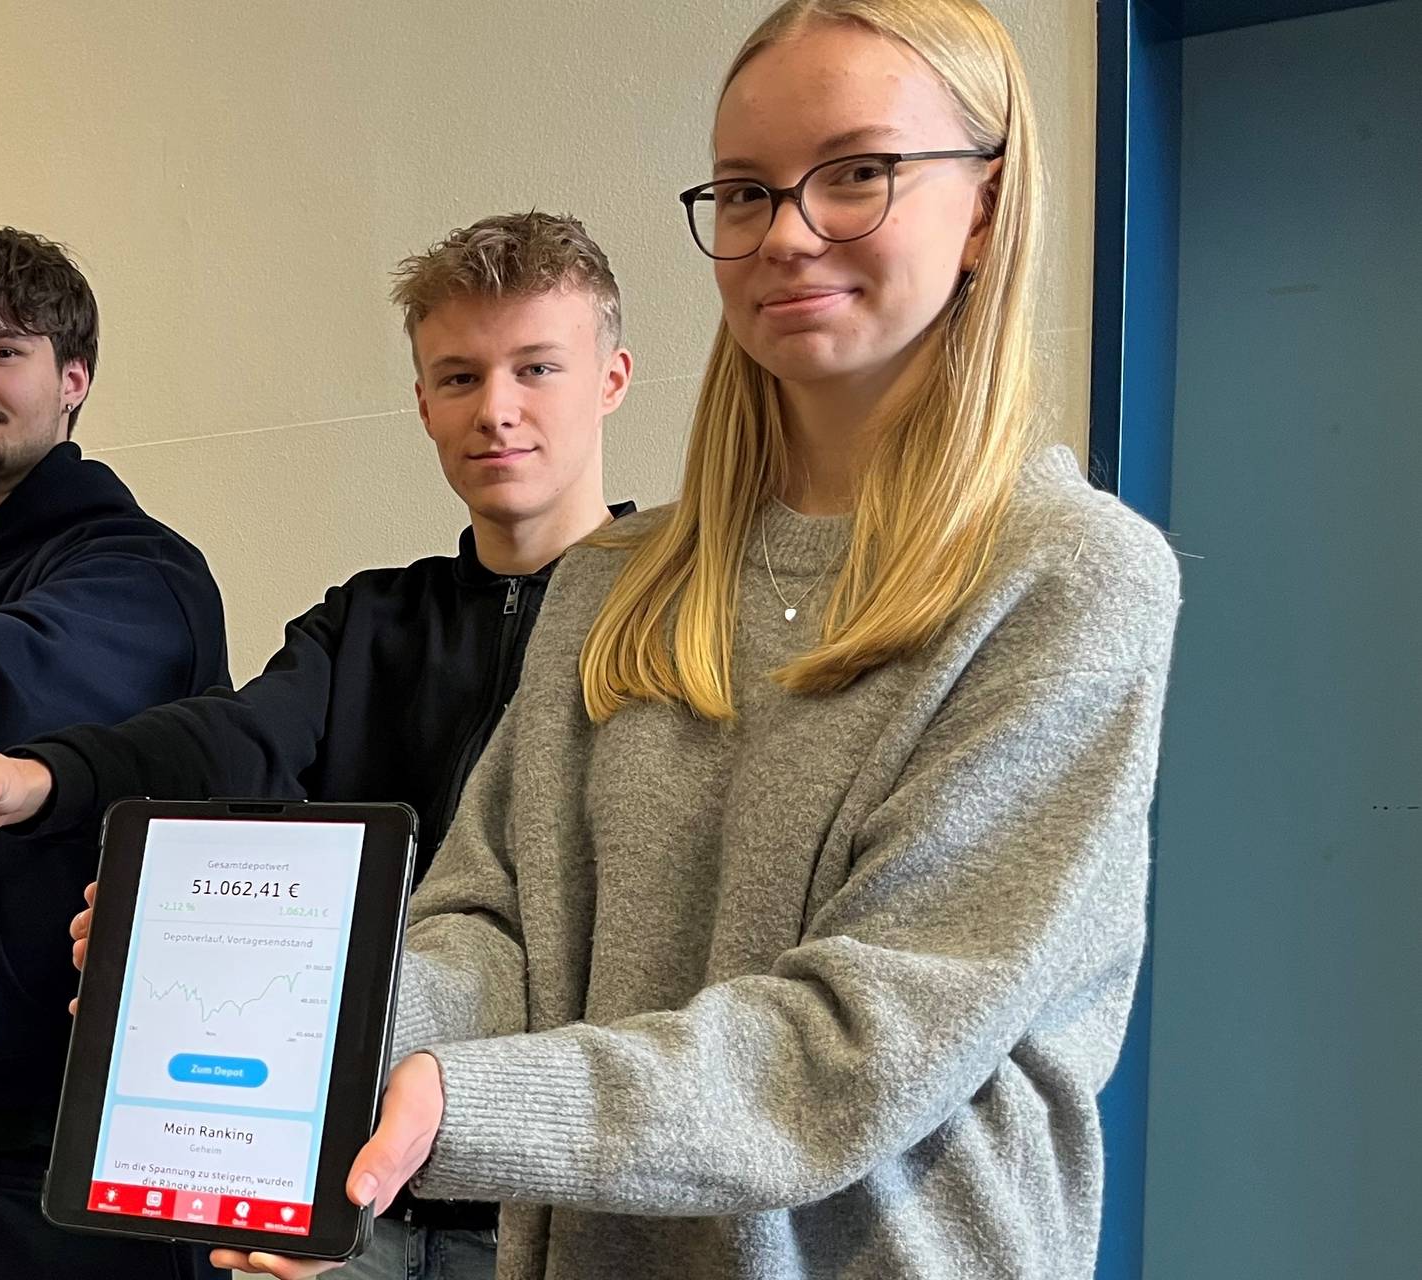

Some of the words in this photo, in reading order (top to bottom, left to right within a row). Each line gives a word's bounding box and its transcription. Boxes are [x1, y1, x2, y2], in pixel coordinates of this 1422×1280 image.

[207, 860, 290, 872] Gesamtdepotwert
[191, 879, 281, 899] 51.062,41
[288, 883, 301, 898] €
[185, 902, 196, 912] %
[278, 906, 319, 918] 1.062,41
[163, 932, 224, 944] Depotverlauf,
[227, 935, 314, 949] Vortagesendstand
[190, 1063, 212, 1075] Zum
[214, 1066, 244, 1078] Depot
[163, 1122, 195, 1137] Mein
[199, 1125, 253, 1144] Ranking
[189, 1144, 222, 1155] Geheim
[114, 1160, 129, 1170] Um
[132, 1161, 146, 1172] die
[149, 1163, 196, 1179] Spannung
[198, 1170, 209, 1179] zu
[212, 1171, 254, 1185] steigern,
[257, 1176, 294, 1188] wurden
[142, 1177, 156, 1186] die
